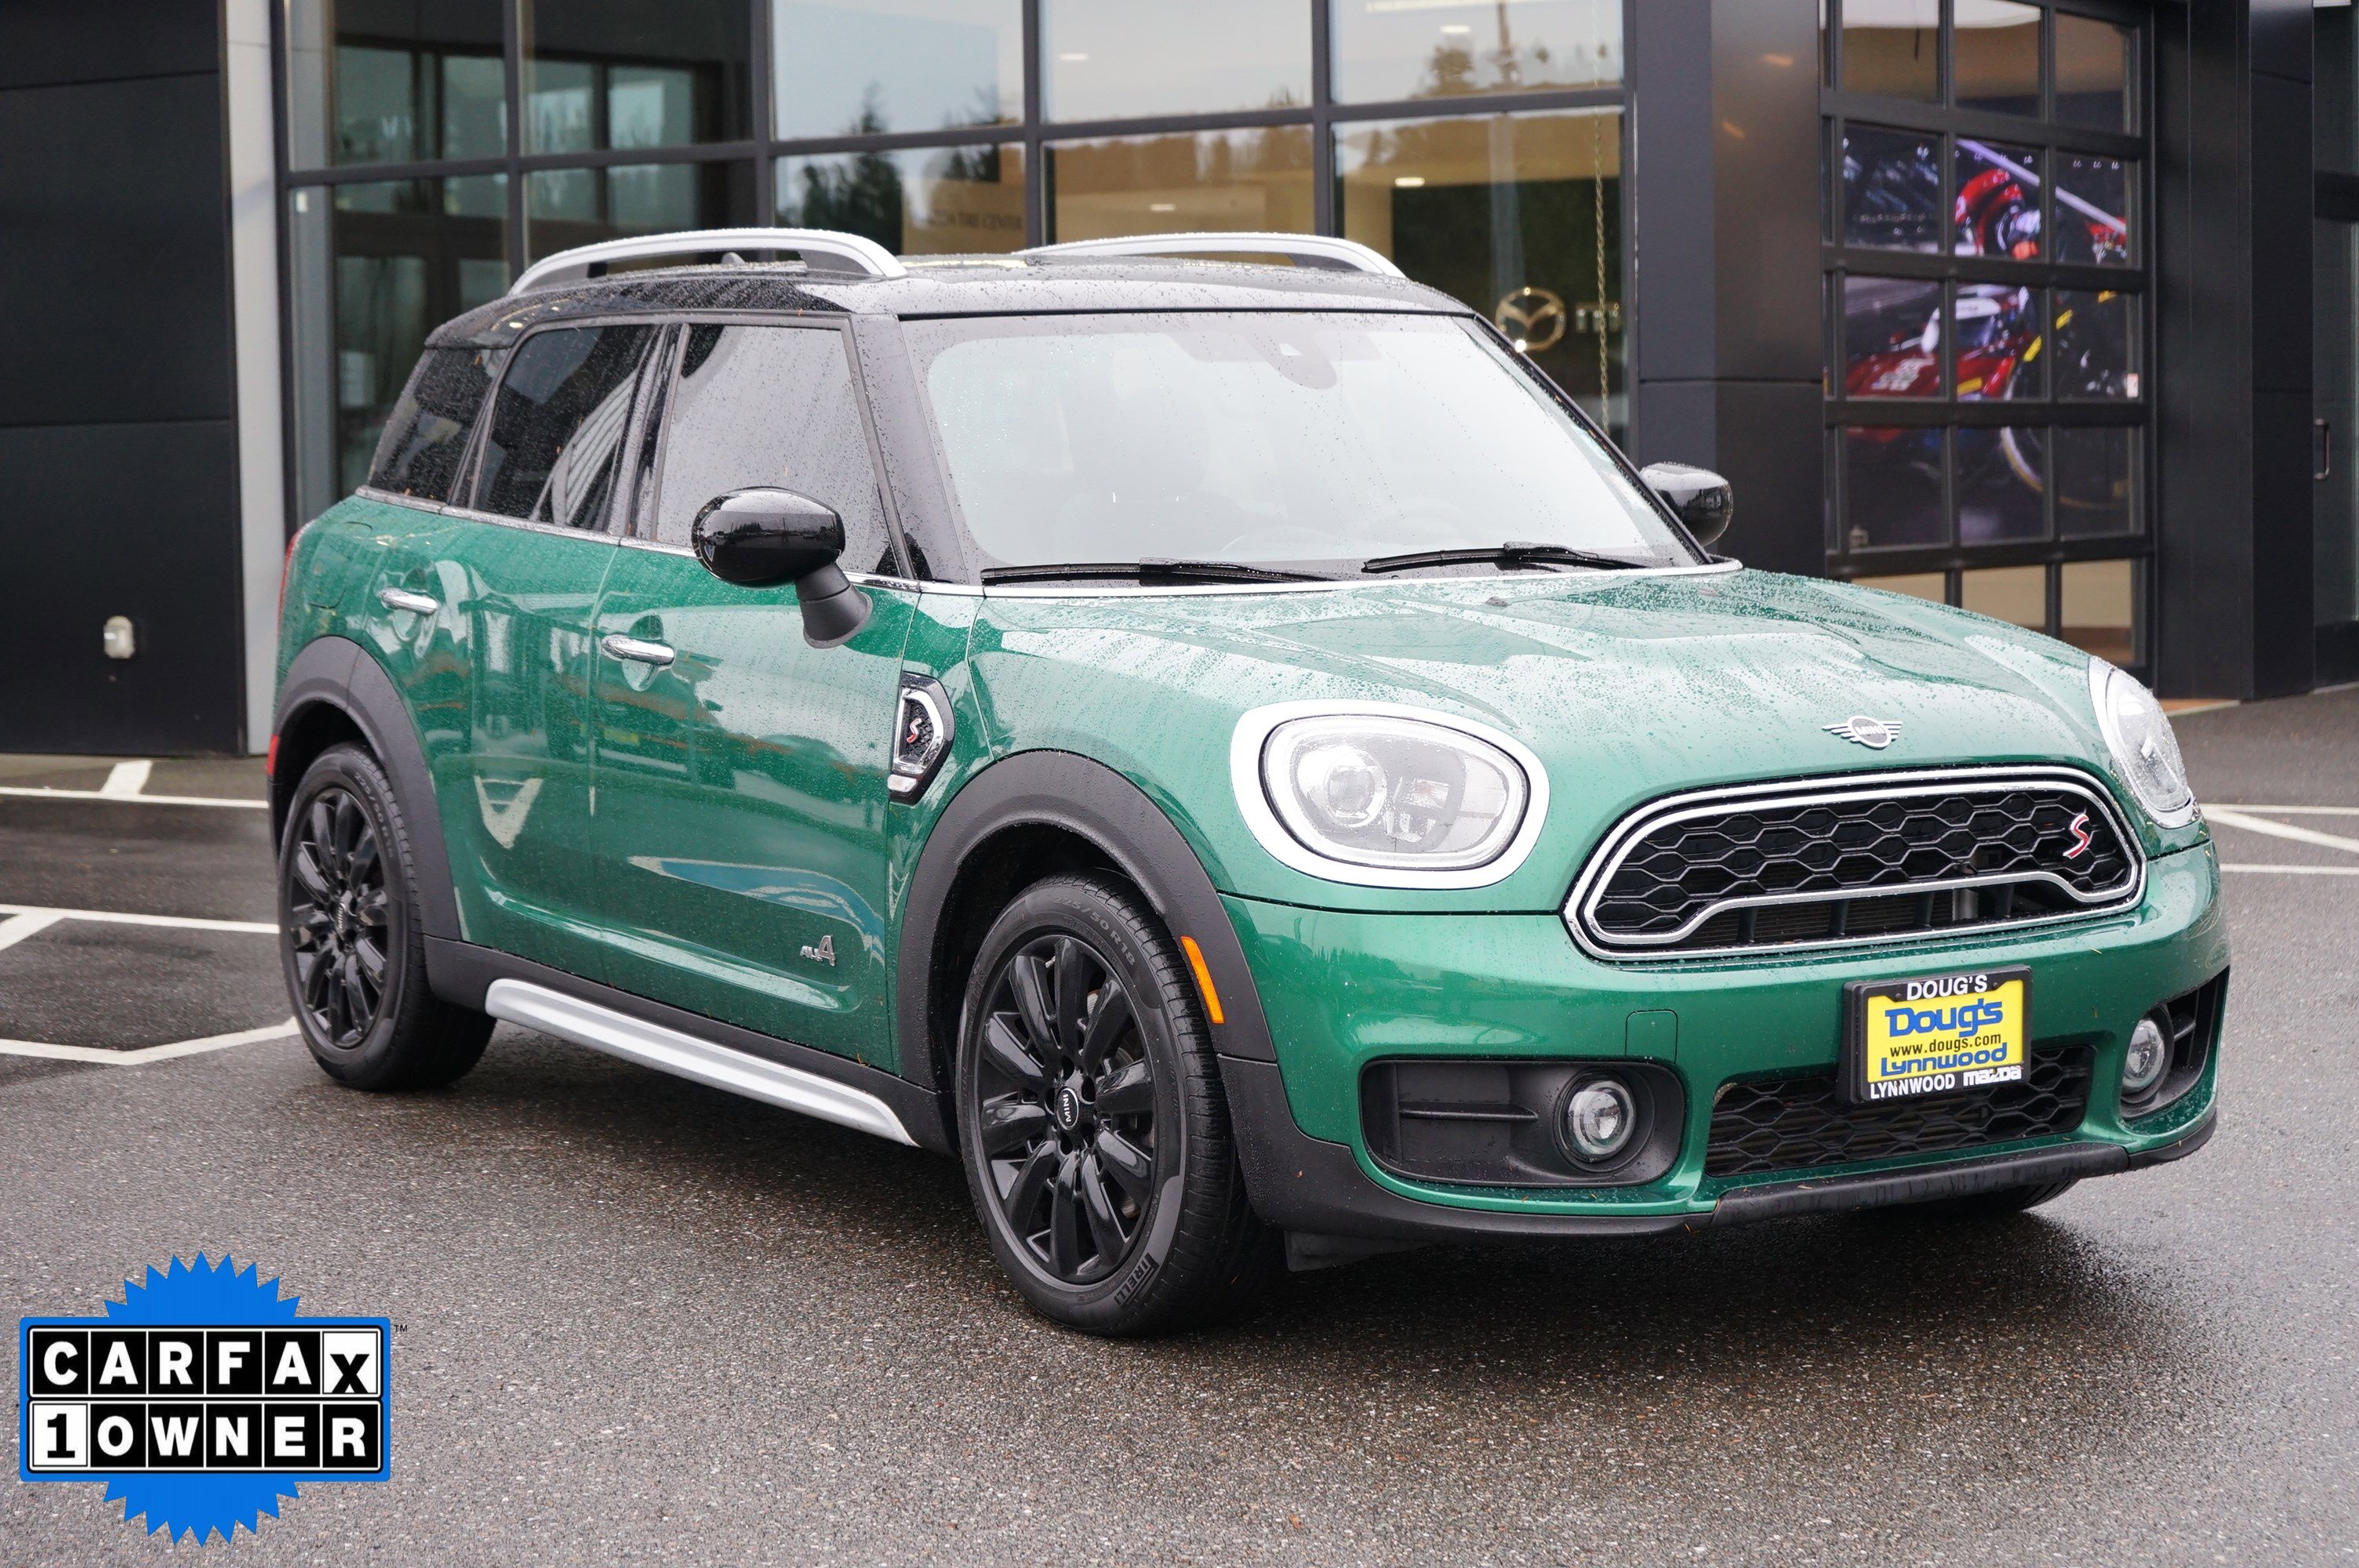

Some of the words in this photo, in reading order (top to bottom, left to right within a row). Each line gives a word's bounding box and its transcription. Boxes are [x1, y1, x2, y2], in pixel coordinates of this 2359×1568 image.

[906, 717, 922, 743] S
[2063, 813, 2090, 859] S
[1906, 975, 1988, 1001] DOUG'S
[1889, 1033, 2001, 1057] www.dougs.com
[1881, 1043, 2008, 1077] Lynnwood
[1870, 1073, 1956, 1099] LYNNWOOD
[1063, 1094, 1072, 1122] MINI
[1114, 1251, 1161, 1308] PIRELLI
